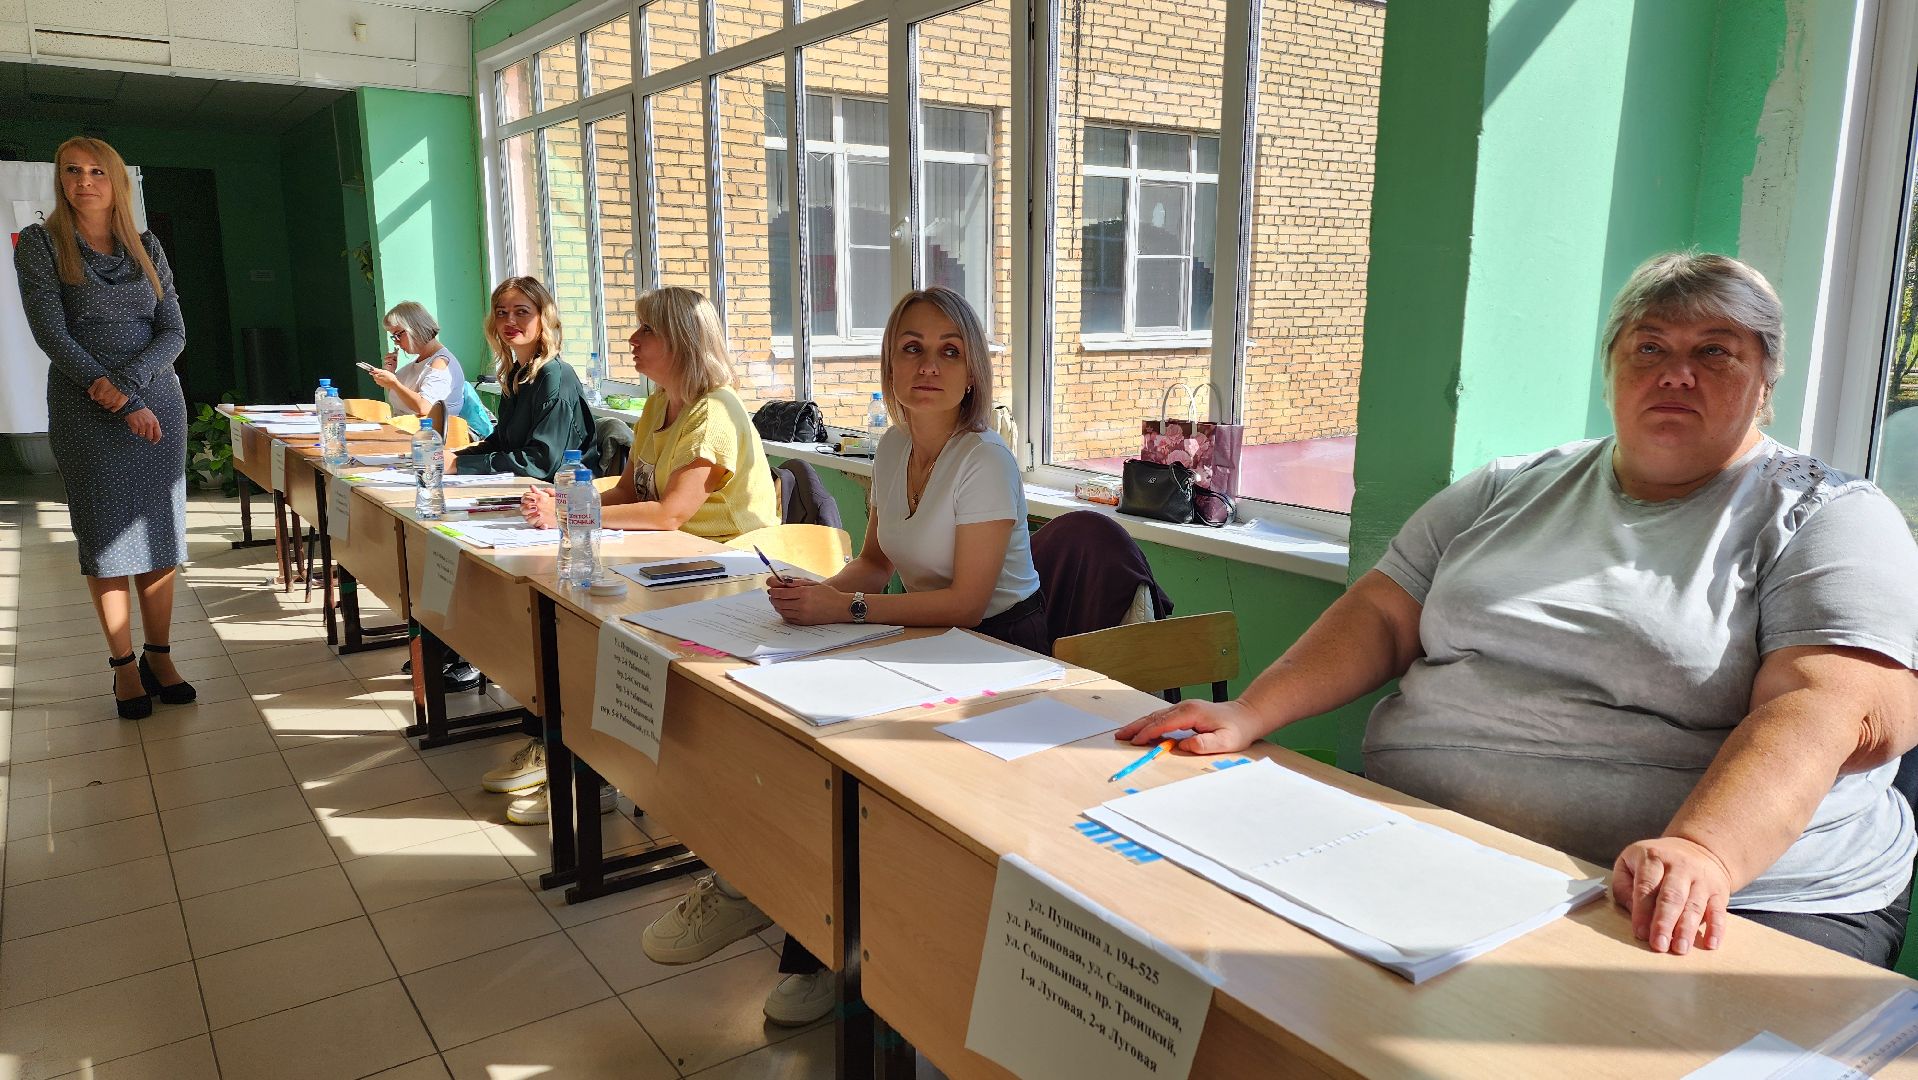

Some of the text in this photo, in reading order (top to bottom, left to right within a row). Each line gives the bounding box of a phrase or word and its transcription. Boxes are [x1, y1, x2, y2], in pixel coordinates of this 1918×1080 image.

[1005, 934, 1178, 1057] ул. Соловьиная, пр. Троицкий,
[1006, 911, 1183, 1032] ул. Рябиновая, ул. Славянская,
[1028, 898, 1160, 985] ул. Пушкина д. 194-525
[1020, 968, 1158, 1073] 1-я Луговая, 2-я Луговая
